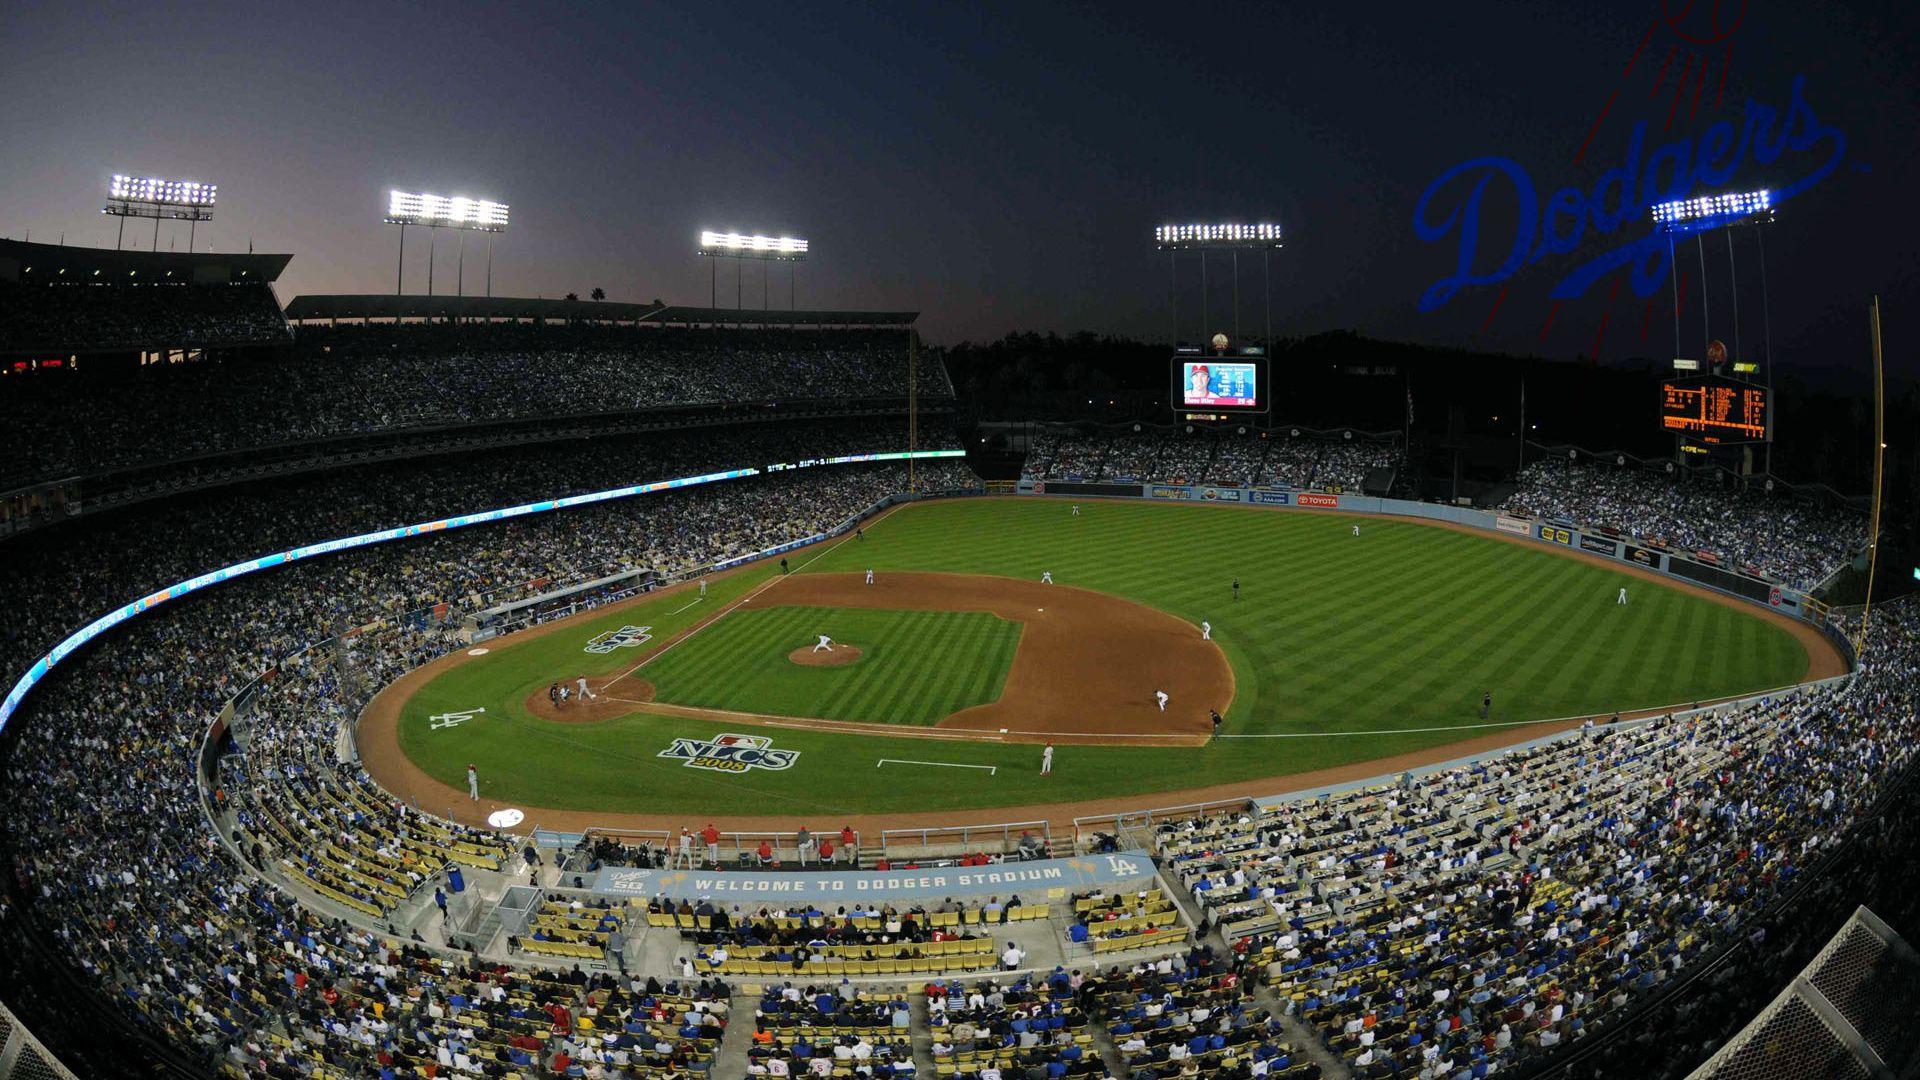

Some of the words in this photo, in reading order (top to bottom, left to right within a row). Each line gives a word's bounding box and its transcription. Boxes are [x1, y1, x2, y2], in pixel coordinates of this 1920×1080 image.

[1309, 497, 1337, 506] TOYOTA
[659, 740, 798, 768] NLCS
[692, 757, 748, 771] 2008
[1105, 856, 1139, 876] LA
[610, 869, 652, 882] Dodgers
[695, 879, 805, 891] WELCOME
[817, 880, 844, 891] TO
[856, 876, 947, 891] DODGER
[959, 867, 1062, 885] STADIUM
